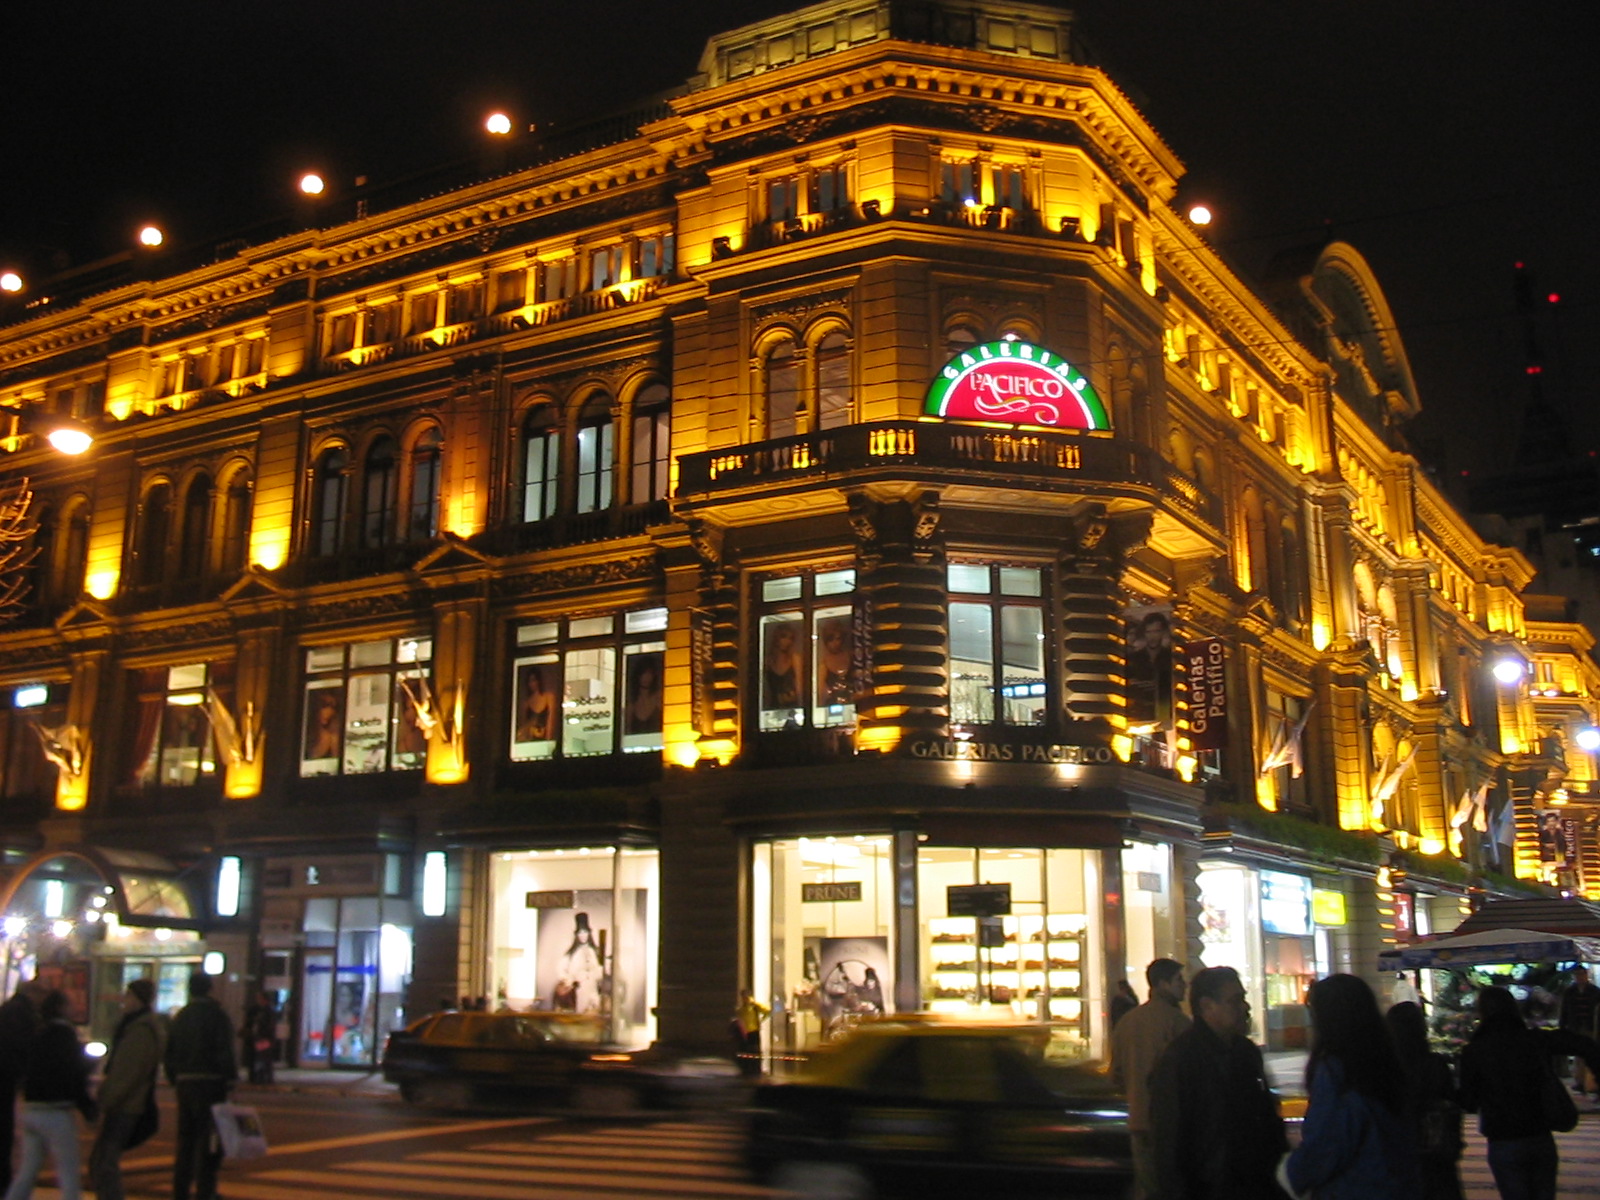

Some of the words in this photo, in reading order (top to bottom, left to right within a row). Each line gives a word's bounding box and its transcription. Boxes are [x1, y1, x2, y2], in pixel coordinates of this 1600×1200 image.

[943, 342, 1088, 391] GALERIAS
[969, 372, 1064, 403] PACIFICO
[692, 629, 704, 726] Shopping
[1188, 656, 1206, 733] Galerías
[1207, 643, 1225, 717] Pacífico
[911, 741, 1014, 761] GALERIAS
